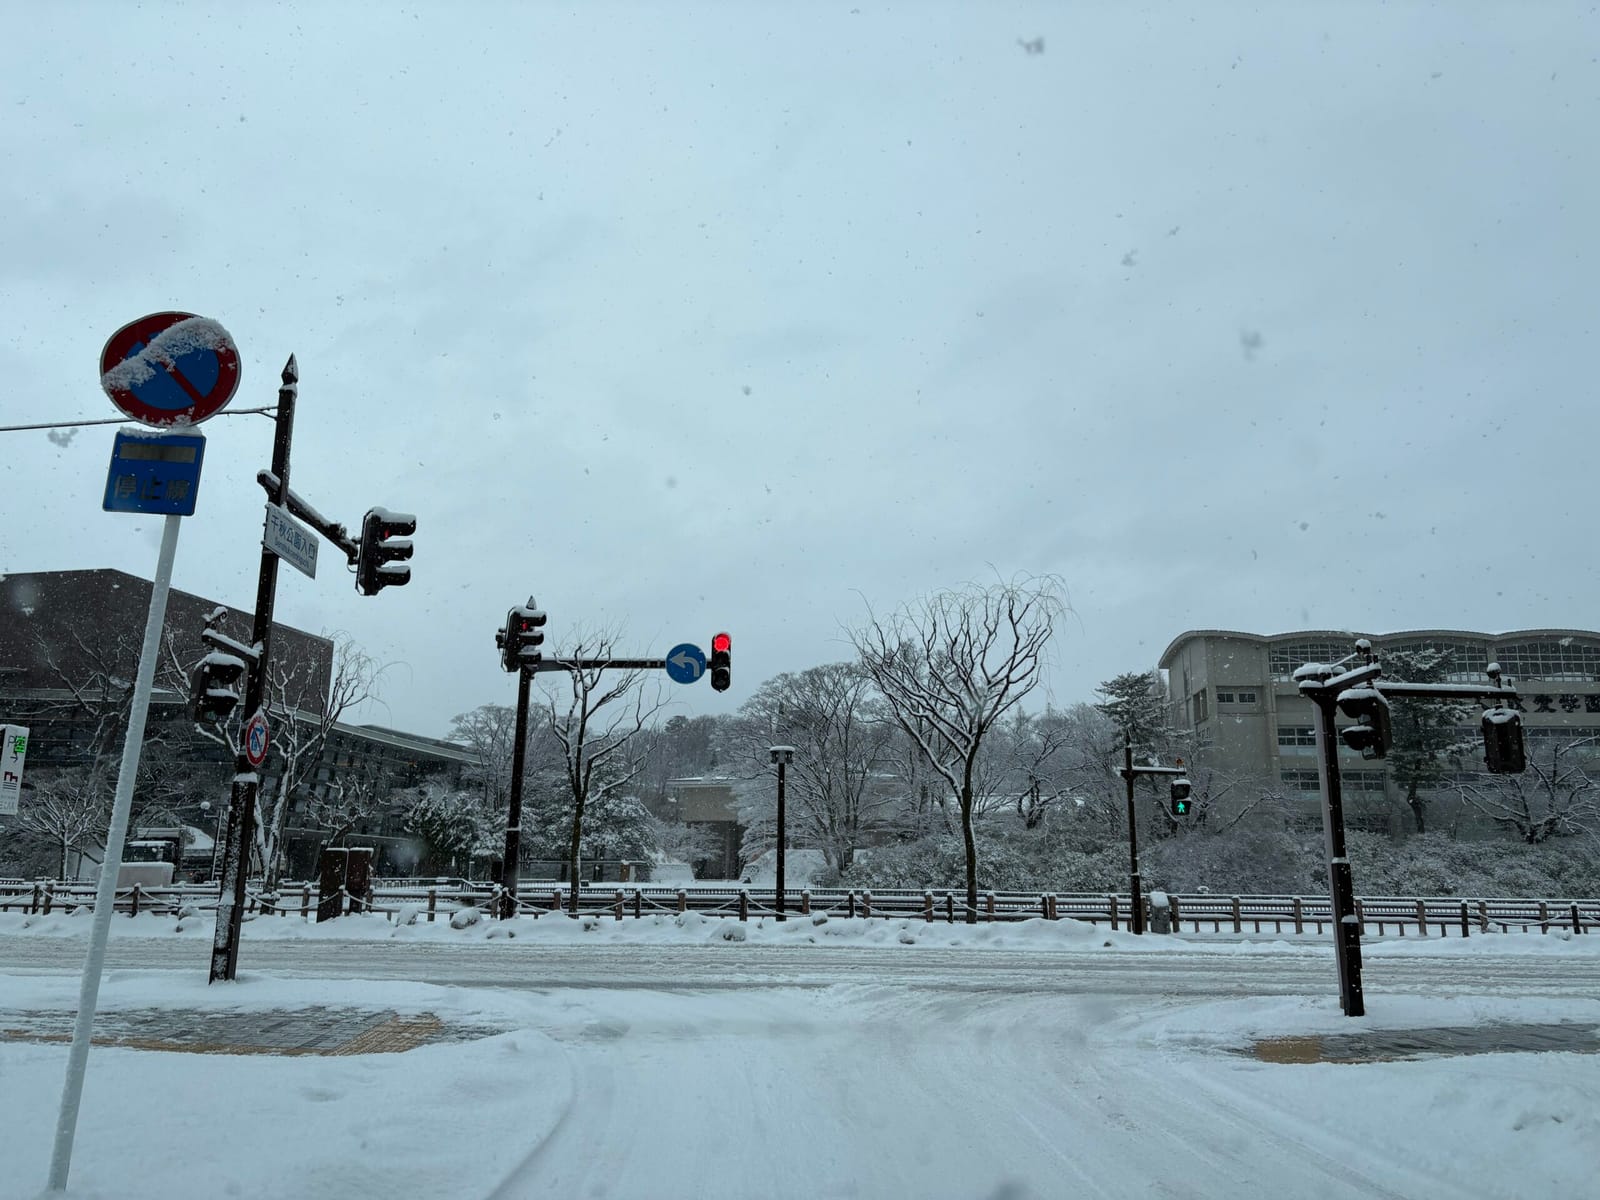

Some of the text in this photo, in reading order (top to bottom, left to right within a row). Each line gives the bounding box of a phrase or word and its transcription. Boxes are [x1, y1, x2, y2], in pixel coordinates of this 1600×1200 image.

[271, 514, 315, 561] 千秋公園入口
